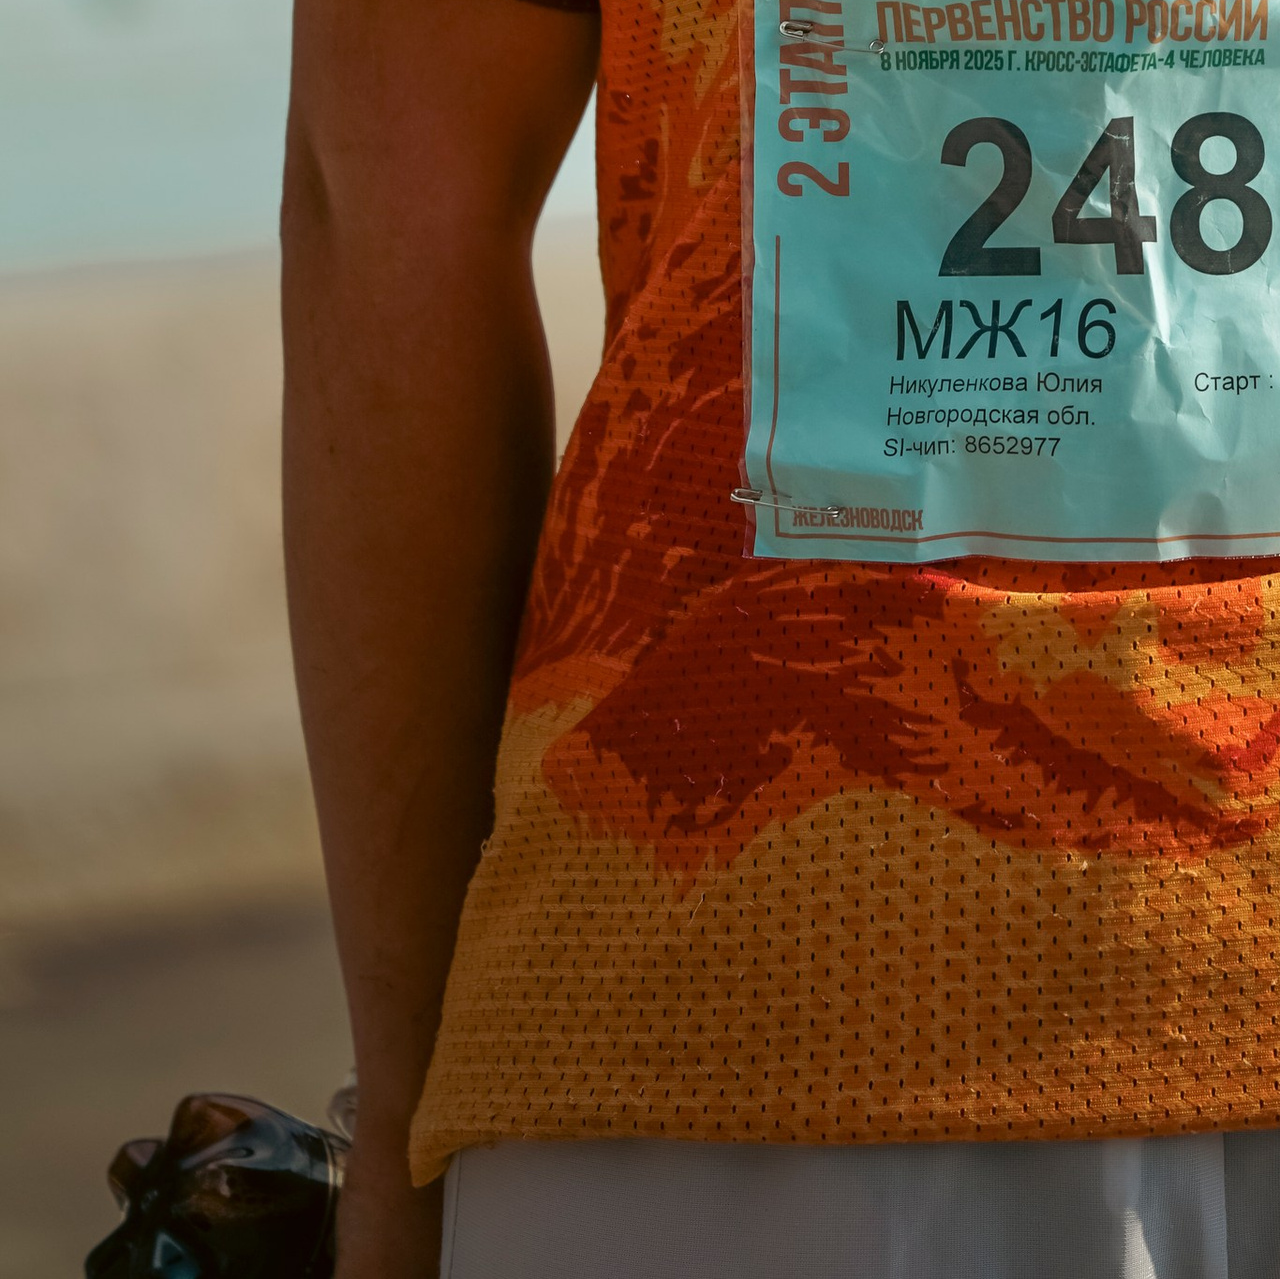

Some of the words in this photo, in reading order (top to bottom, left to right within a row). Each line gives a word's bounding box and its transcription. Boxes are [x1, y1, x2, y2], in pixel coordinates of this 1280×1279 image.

[881, 50, 892, 72] 8
[896, 49, 959, 71] НОЯБРЯ
[964, 49, 1005, 72] 2025
[1008, 49, 1021, 72] Г.
[1180, 48, 1266, 69] ЧЕЛОВЕКА
[777, 161, 850, 197] 2
[938, 111, 1274, 277] 248
[896, 298, 1117, 361] МЖ16
[889, 375, 1028, 398] Никуленкова
[1036, 372, 1103, 393] Юлия
[1194, 372, 1261, 395] Старт
[887, 407, 1039, 427] Новгородская
[1047, 405, 1096, 426] обл.
[883, 437, 956, 457] SI-чип:
[964, 435, 1061, 457] 8652977
